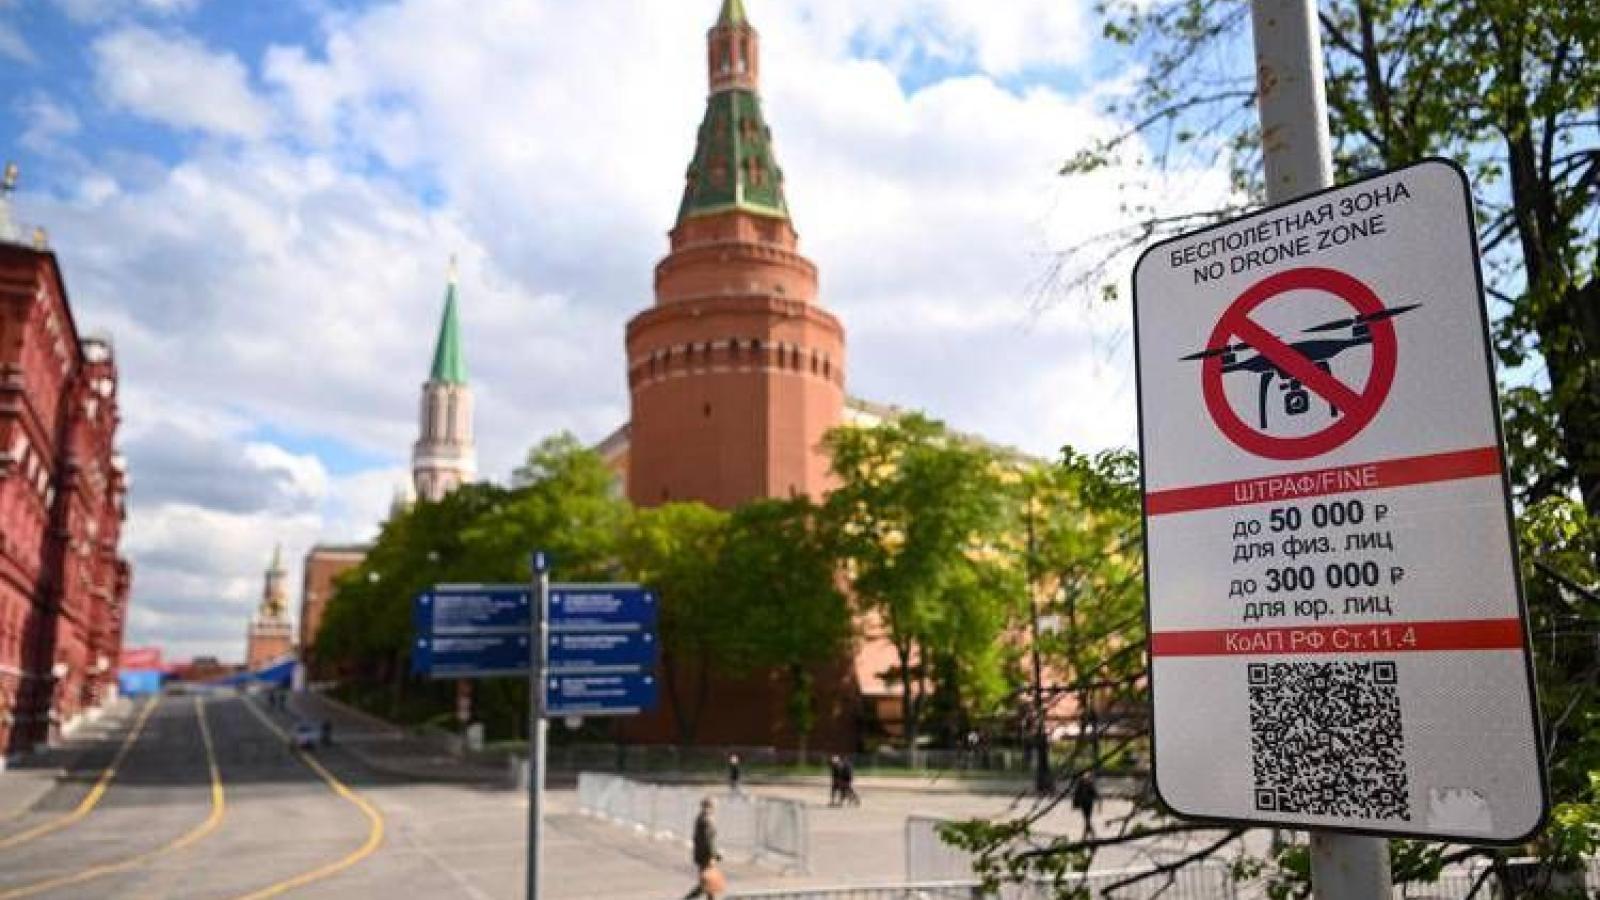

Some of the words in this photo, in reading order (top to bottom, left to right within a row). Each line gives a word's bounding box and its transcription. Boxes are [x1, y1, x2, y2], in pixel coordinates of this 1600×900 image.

[1340, 182, 1411, 217] ЗОНА
[1194, 261, 1225, 285] NO
[1230, 235, 1311, 275] DRONE
[1316, 214, 1387, 250] ZONE
[1234, 466, 1378, 502] ШТРАФ/FINE
[1233, 519, 1261, 541] до
[1269, 507, 1302, 533] 50
[1312, 499, 1364, 529] 000
[1233, 541, 1275, 563] для
[1282, 534, 1336, 560] физ.
[1344, 530, 1394, 553] лиц
[1228, 579, 1257, 599] до
[1265, 565, 1315, 593] 300
[1326, 560, 1379, 589] 000
[1243, 600, 1285, 622] для
[1294, 598, 1334, 622] юр.
[1343, 594, 1393, 617] лиц
[1226, 631, 1283, 651] КоАП
[1290, 630, 1325, 651] РФ
[1332, 626, 1417, 649] Ст.11.4
